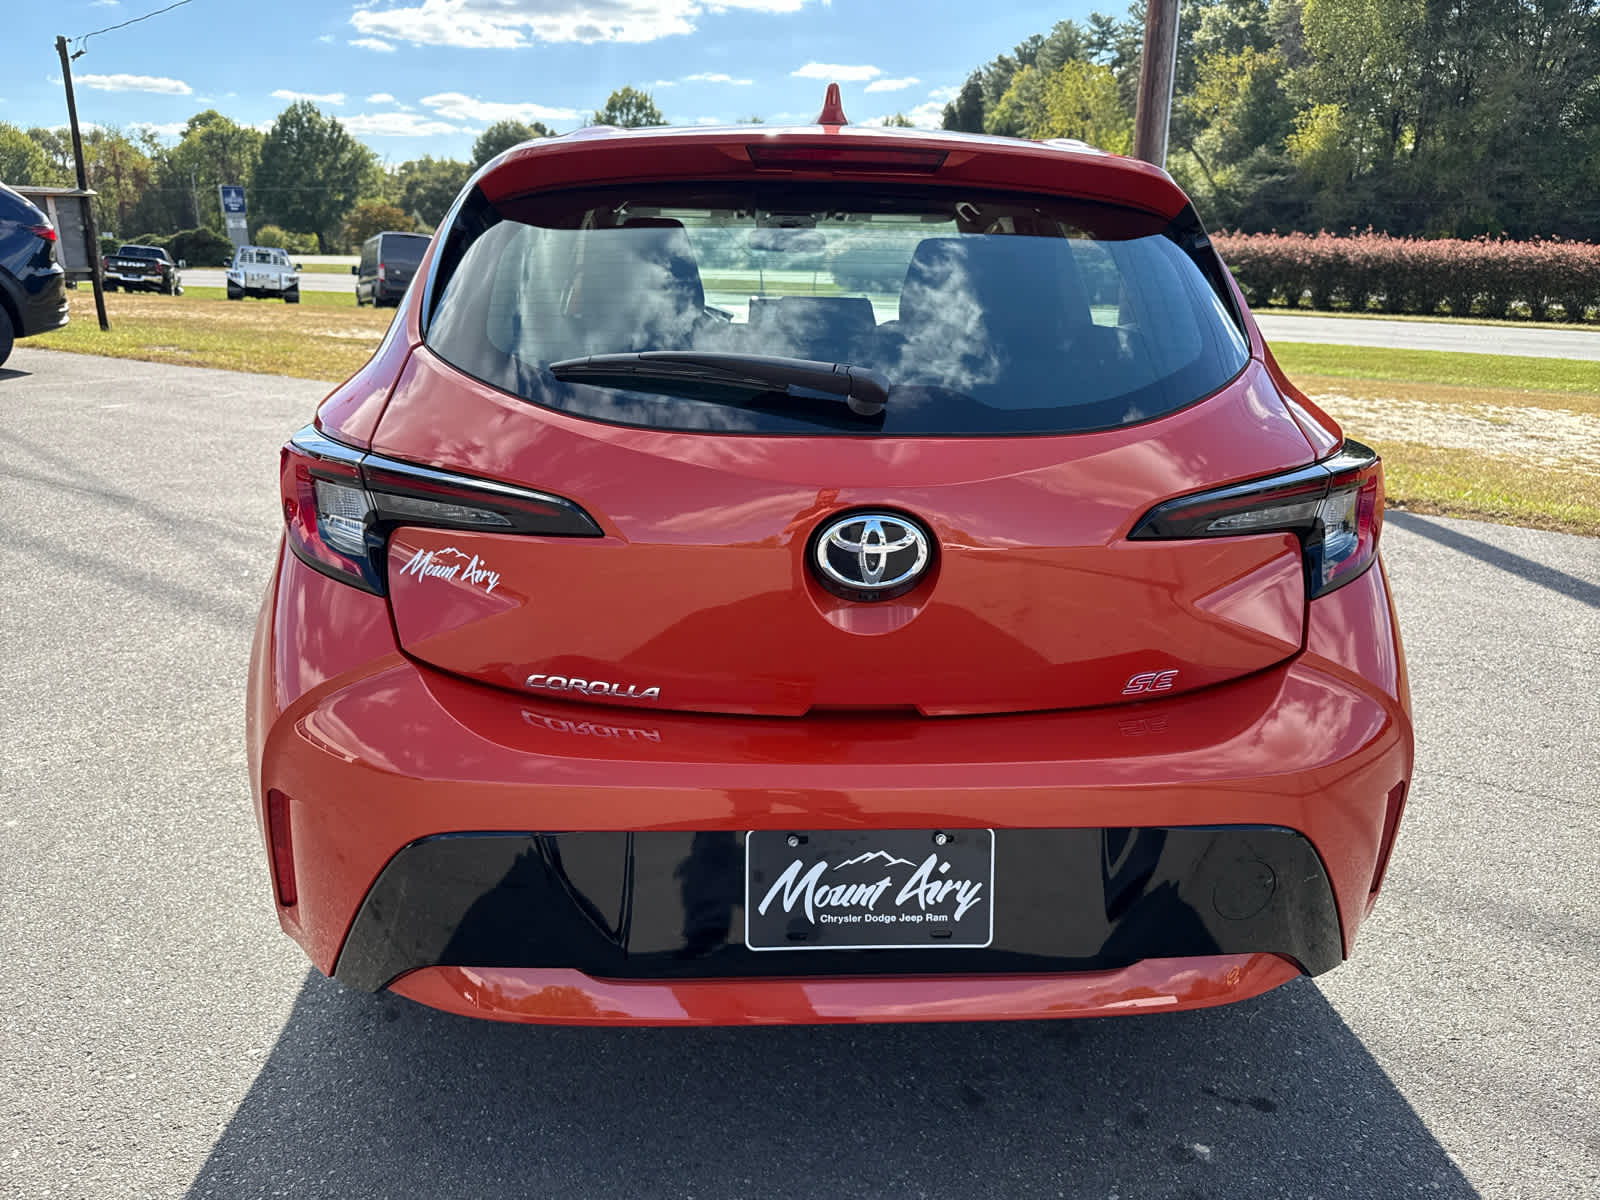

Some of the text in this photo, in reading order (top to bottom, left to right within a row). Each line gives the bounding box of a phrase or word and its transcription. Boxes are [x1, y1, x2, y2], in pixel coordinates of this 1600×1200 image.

[399, 548, 501, 594] Mount Airy
[525, 673, 661, 700] COROLLA
[1122, 669, 1179, 694] SE
[758, 853, 983, 925] Mount Airy
[820, 912, 949, 925] Chrysler Dodge Jeep Ram
